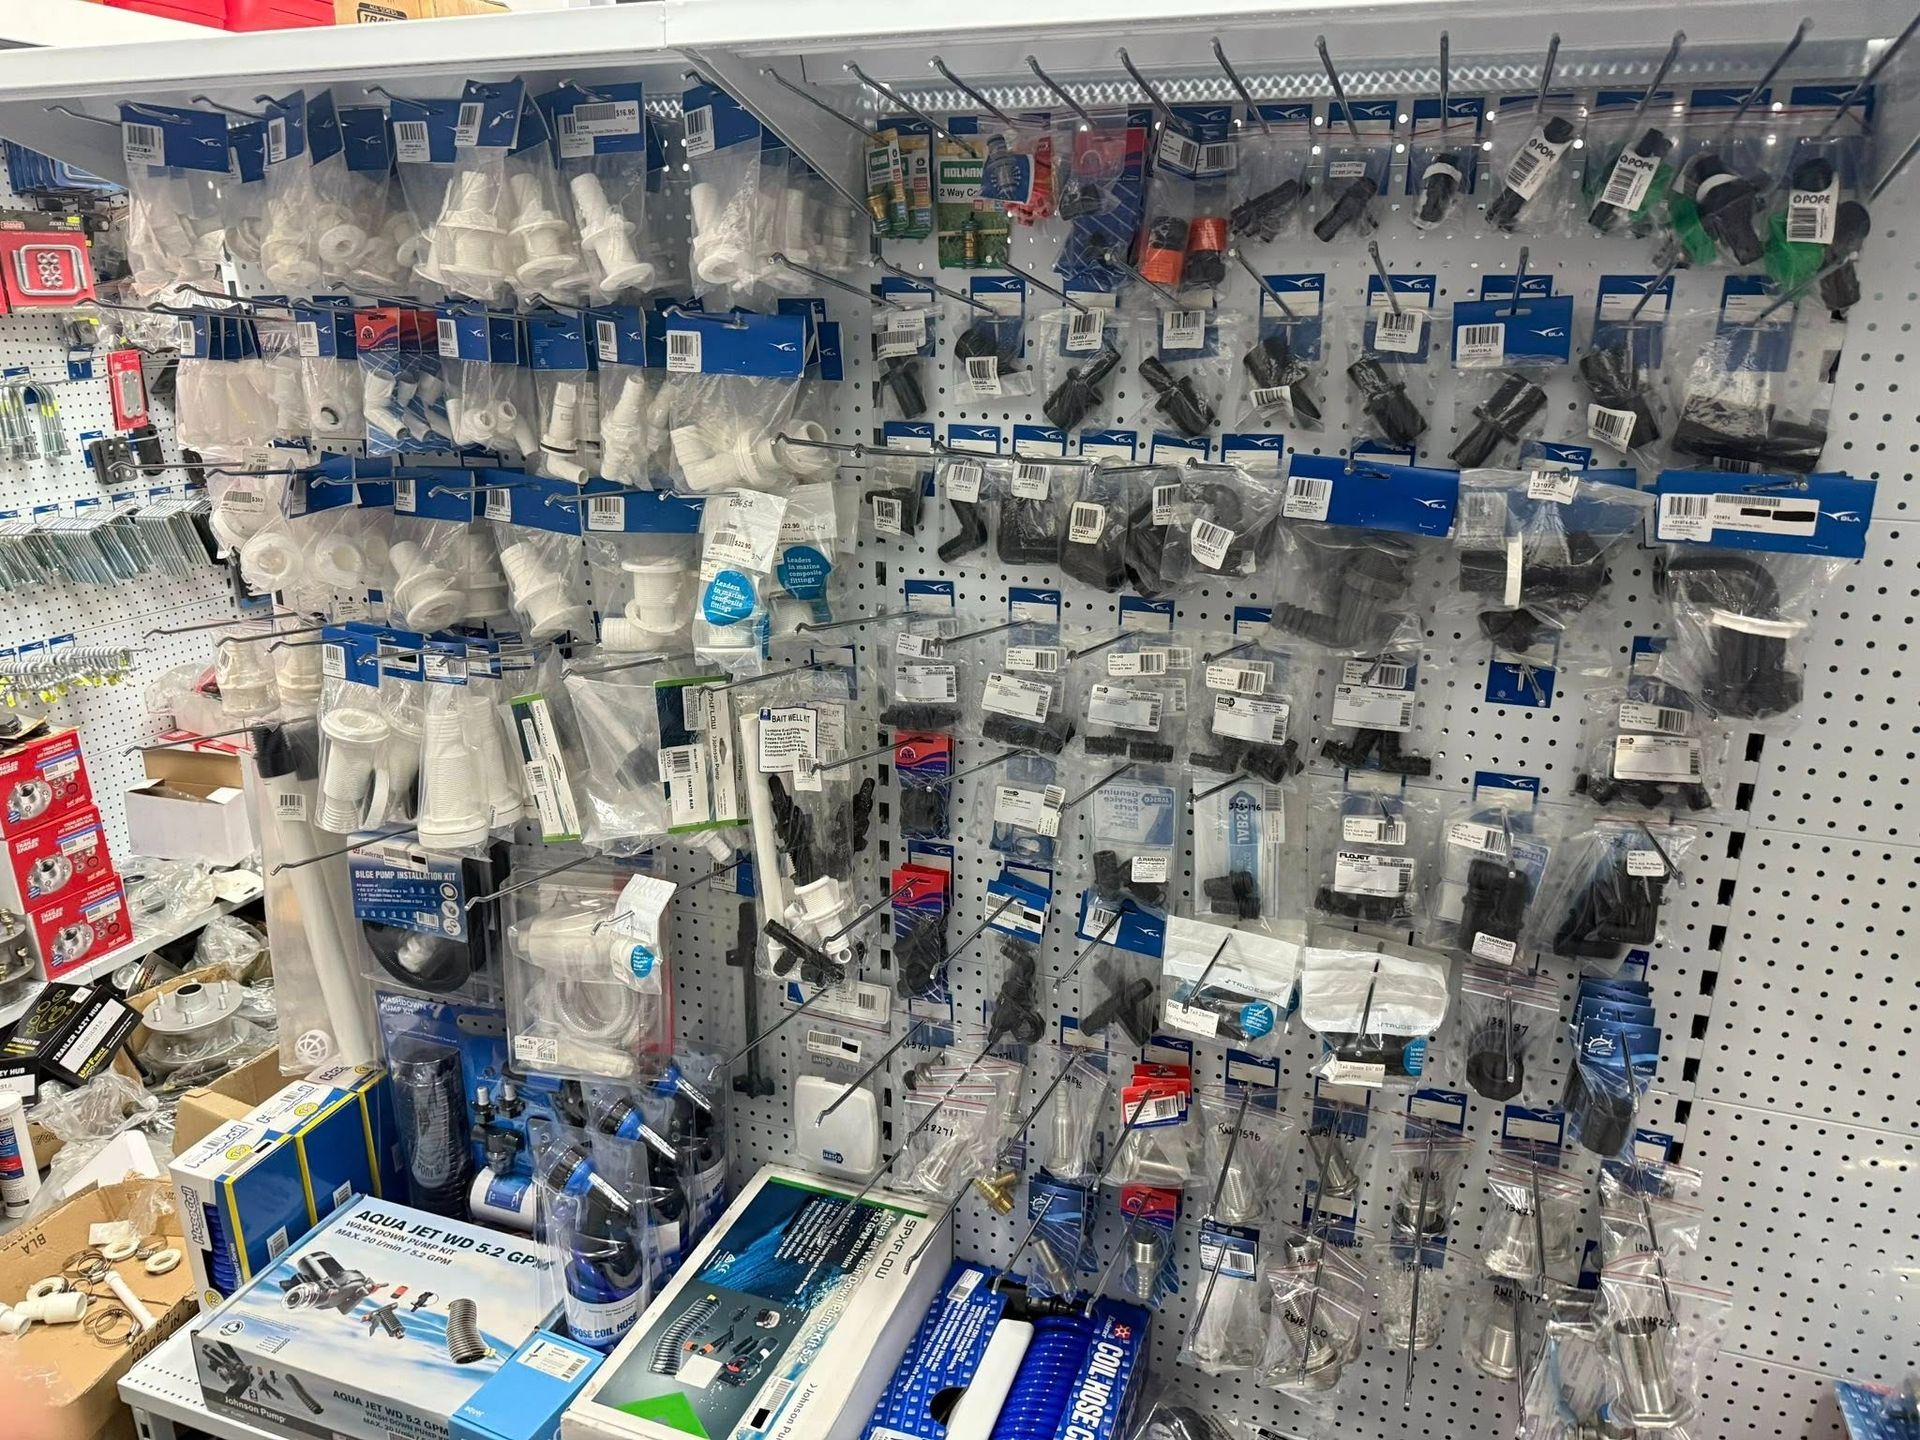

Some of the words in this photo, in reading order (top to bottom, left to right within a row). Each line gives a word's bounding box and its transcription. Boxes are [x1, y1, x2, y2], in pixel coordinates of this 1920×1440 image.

[615, 108, 636, 117] $16.90
[943, 167, 983, 178] HOLMAN
[1628, 157, 1654, 171] POPE
[940, 188, 945, 197] 2
[947, 188, 965, 199] Way
[1802, 194, 1831, 204] POPE
[1840, 515, 1860, 523] BLA
[734, 539, 751, 549] $22.90
[716, 579, 740, 591] Leaders
[712, 595, 743, 608] composite
[772, 714, 787, 723] BAIT
[788, 714, 803, 722] WELL
[1339, 853, 1370, 861] FLOJET
[355, 871, 374, 879] BILGE
[375, 870, 395, 879] PUMP
[397, 871, 442, 881] INSTALLATION
[444, 872, 456, 880] KIT
[1487, 937, 1513, 948] WARNING
[379, 995, 428, 1011] WASHDOWN
[380, 1003, 400, 1014] PUMP
[52, 1035, 78, 1061] TRAILER
[74, 1015, 91, 1035] LAZY
[89, 1003, 102, 1017] HUB
[9, 1068, 25, 1076] HUB
[823, 1152, 842, 1162] JABSCO
[182, 1185, 205, 1245] HoseCoil
[857, 1220, 875, 1240] GPM
[874, 1213, 896, 1238] Aqua
[22, 1233, 47, 1254] BLA
[335, 1227, 360, 1243] MAX.
[362, 1236, 377, 1246] 20
[409, 1250, 426, 1259] 5.2
[426, 1253, 453, 1266] GPM
[346, 1220, 376, 1234] WASH
[376, 1228, 408, 1242] DOWN
[407, 1237, 440, 1251] PUMP
[440, 1246, 457, 1256] KIT
[355, 1210, 407, 1231] AQUA
[408, 1224, 442, 1239] JET
[444, 1233, 475, 1249] WD
[475, 1243, 506, 1258] 5.2
[507, 1251, 555, 1271] GPM
[867, 1235, 883, 1251] Jet
[873, 1217, 917, 1280] SPXFLOW
[851, 1248, 875, 1276] Wash
[834, 1274, 858, 1303] Down
[570, 1326, 592, 1339] POSE
[594, 1327, 614, 1338] COIL
[617, 1312, 638, 1333] HOSE
[814, 1301, 842, 1332] Pump
[805, 1330, 823, 1349] Kit
[797, 1349, 813, 1364] 5.2
[1088, 1341, 1123, 1380] COIL
[224, 1395, 259, 1415] Johnson
[260, 1407, 287, 1424] Pump
[333, 1390, 362, 1408] AQUA
[365, 1399, 385, 1411] JET
[385, 1405, 403, 1419] WD
[405, 1414, 421, 1425] 5.2
[423, 1419, 449, 1436] GPM
[789, 1388, 811, 1425] Johnson
[1071, 1378, 1112, 1430] HOSE
[365, 1410, 390, 1423] WASH
[390, 1418, 415, 1431] DOWN
[414, 1425, 437, 1438] PUMP
